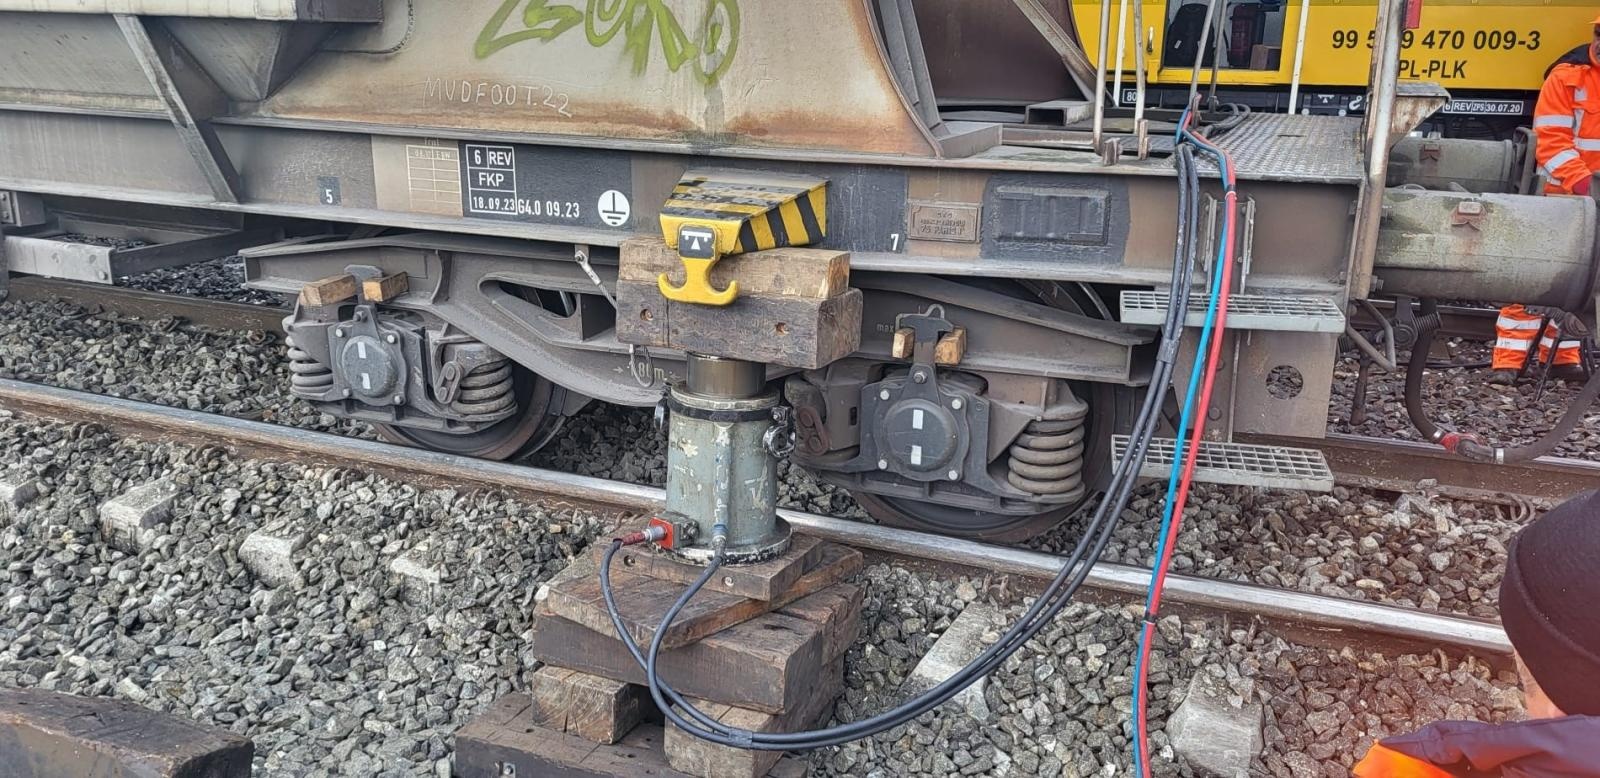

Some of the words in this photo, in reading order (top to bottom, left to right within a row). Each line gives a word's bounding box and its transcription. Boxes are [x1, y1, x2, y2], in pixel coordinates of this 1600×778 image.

[1332, 30, 1358, 49] 99
[1422, 30, 1465, 50] 470
[1473, 30, 1541, 51] 009-3
[1397, 60, 1467, 79] PL-PLK
[1454, 102, 1472, 111] REV
[1485, 103, 1521, 113] 30.07.20
[474, 149, 482, 165] 6
[488, 151, 512, 166] REV
[478, 172, 504, 187] FKP
[325, 189, 334, 204] 5
[472, 196, 516, 211] 18.09.23
[545, 201, 581, 218] 09.23
[890, 233, 899, 251] 7
